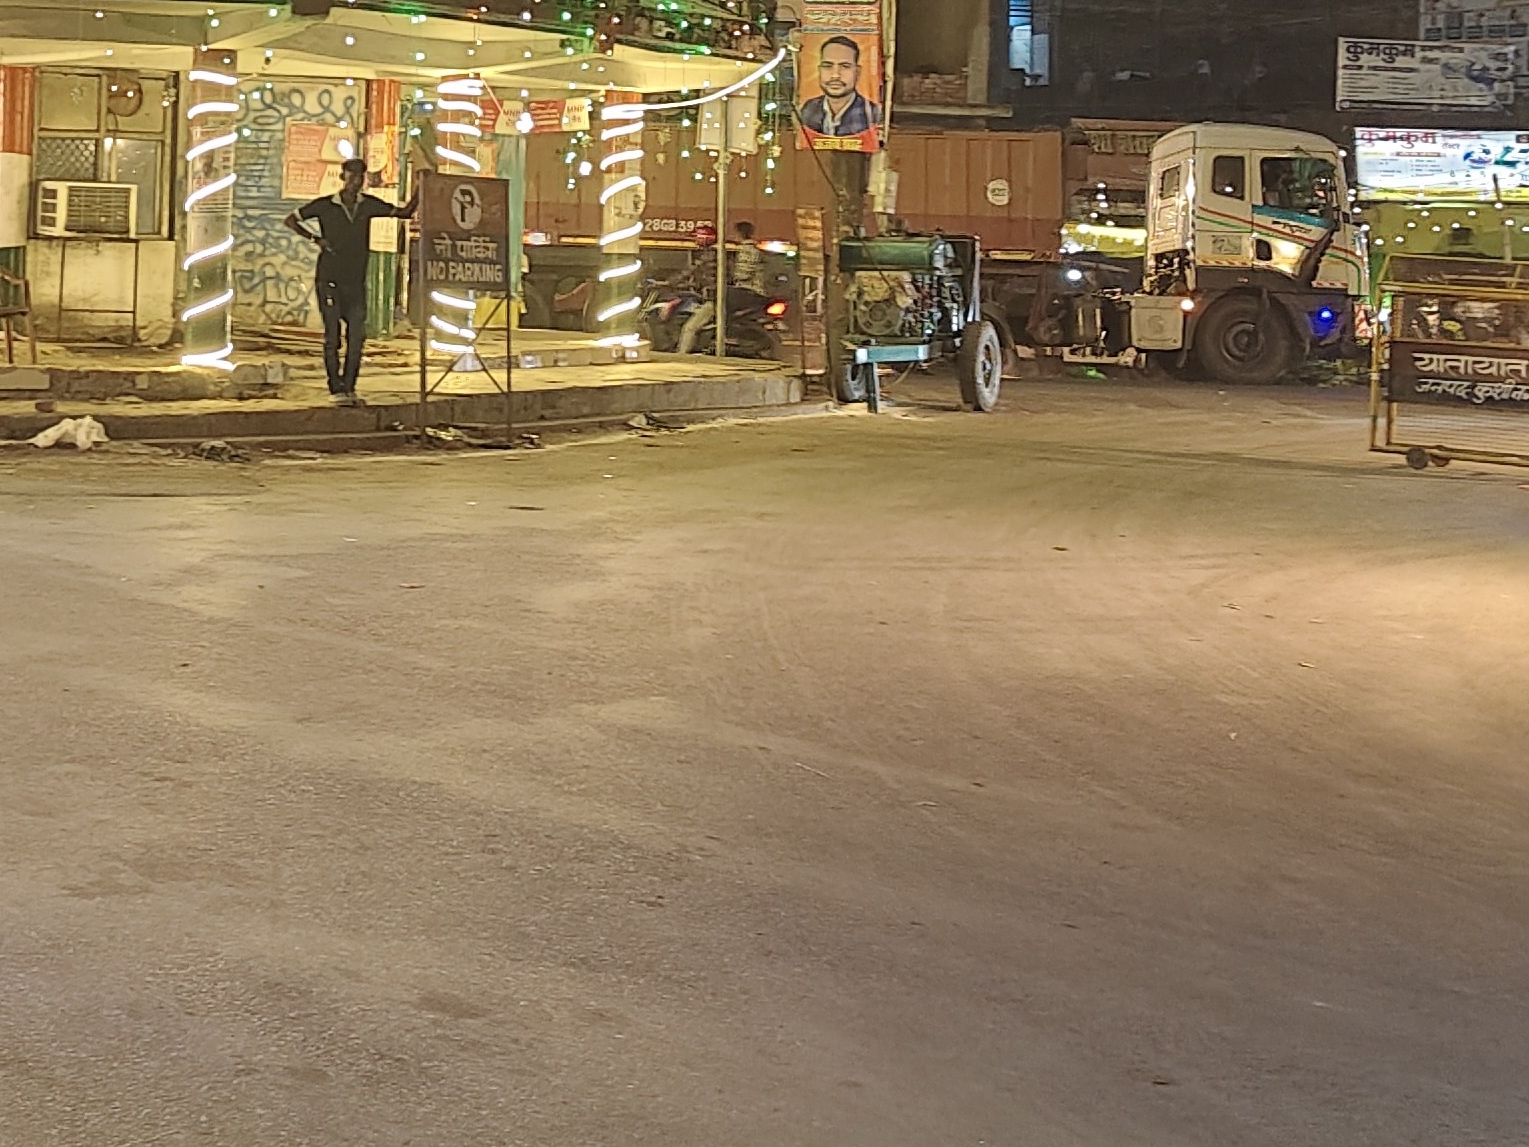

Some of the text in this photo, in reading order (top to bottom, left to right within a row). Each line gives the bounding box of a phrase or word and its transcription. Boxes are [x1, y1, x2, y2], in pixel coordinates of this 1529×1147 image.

[427, 261, 503, 282] NO PARKING
[1412, 353, 1529, 382] यातायात
[1415, 379, 1472, 400] जनपद
